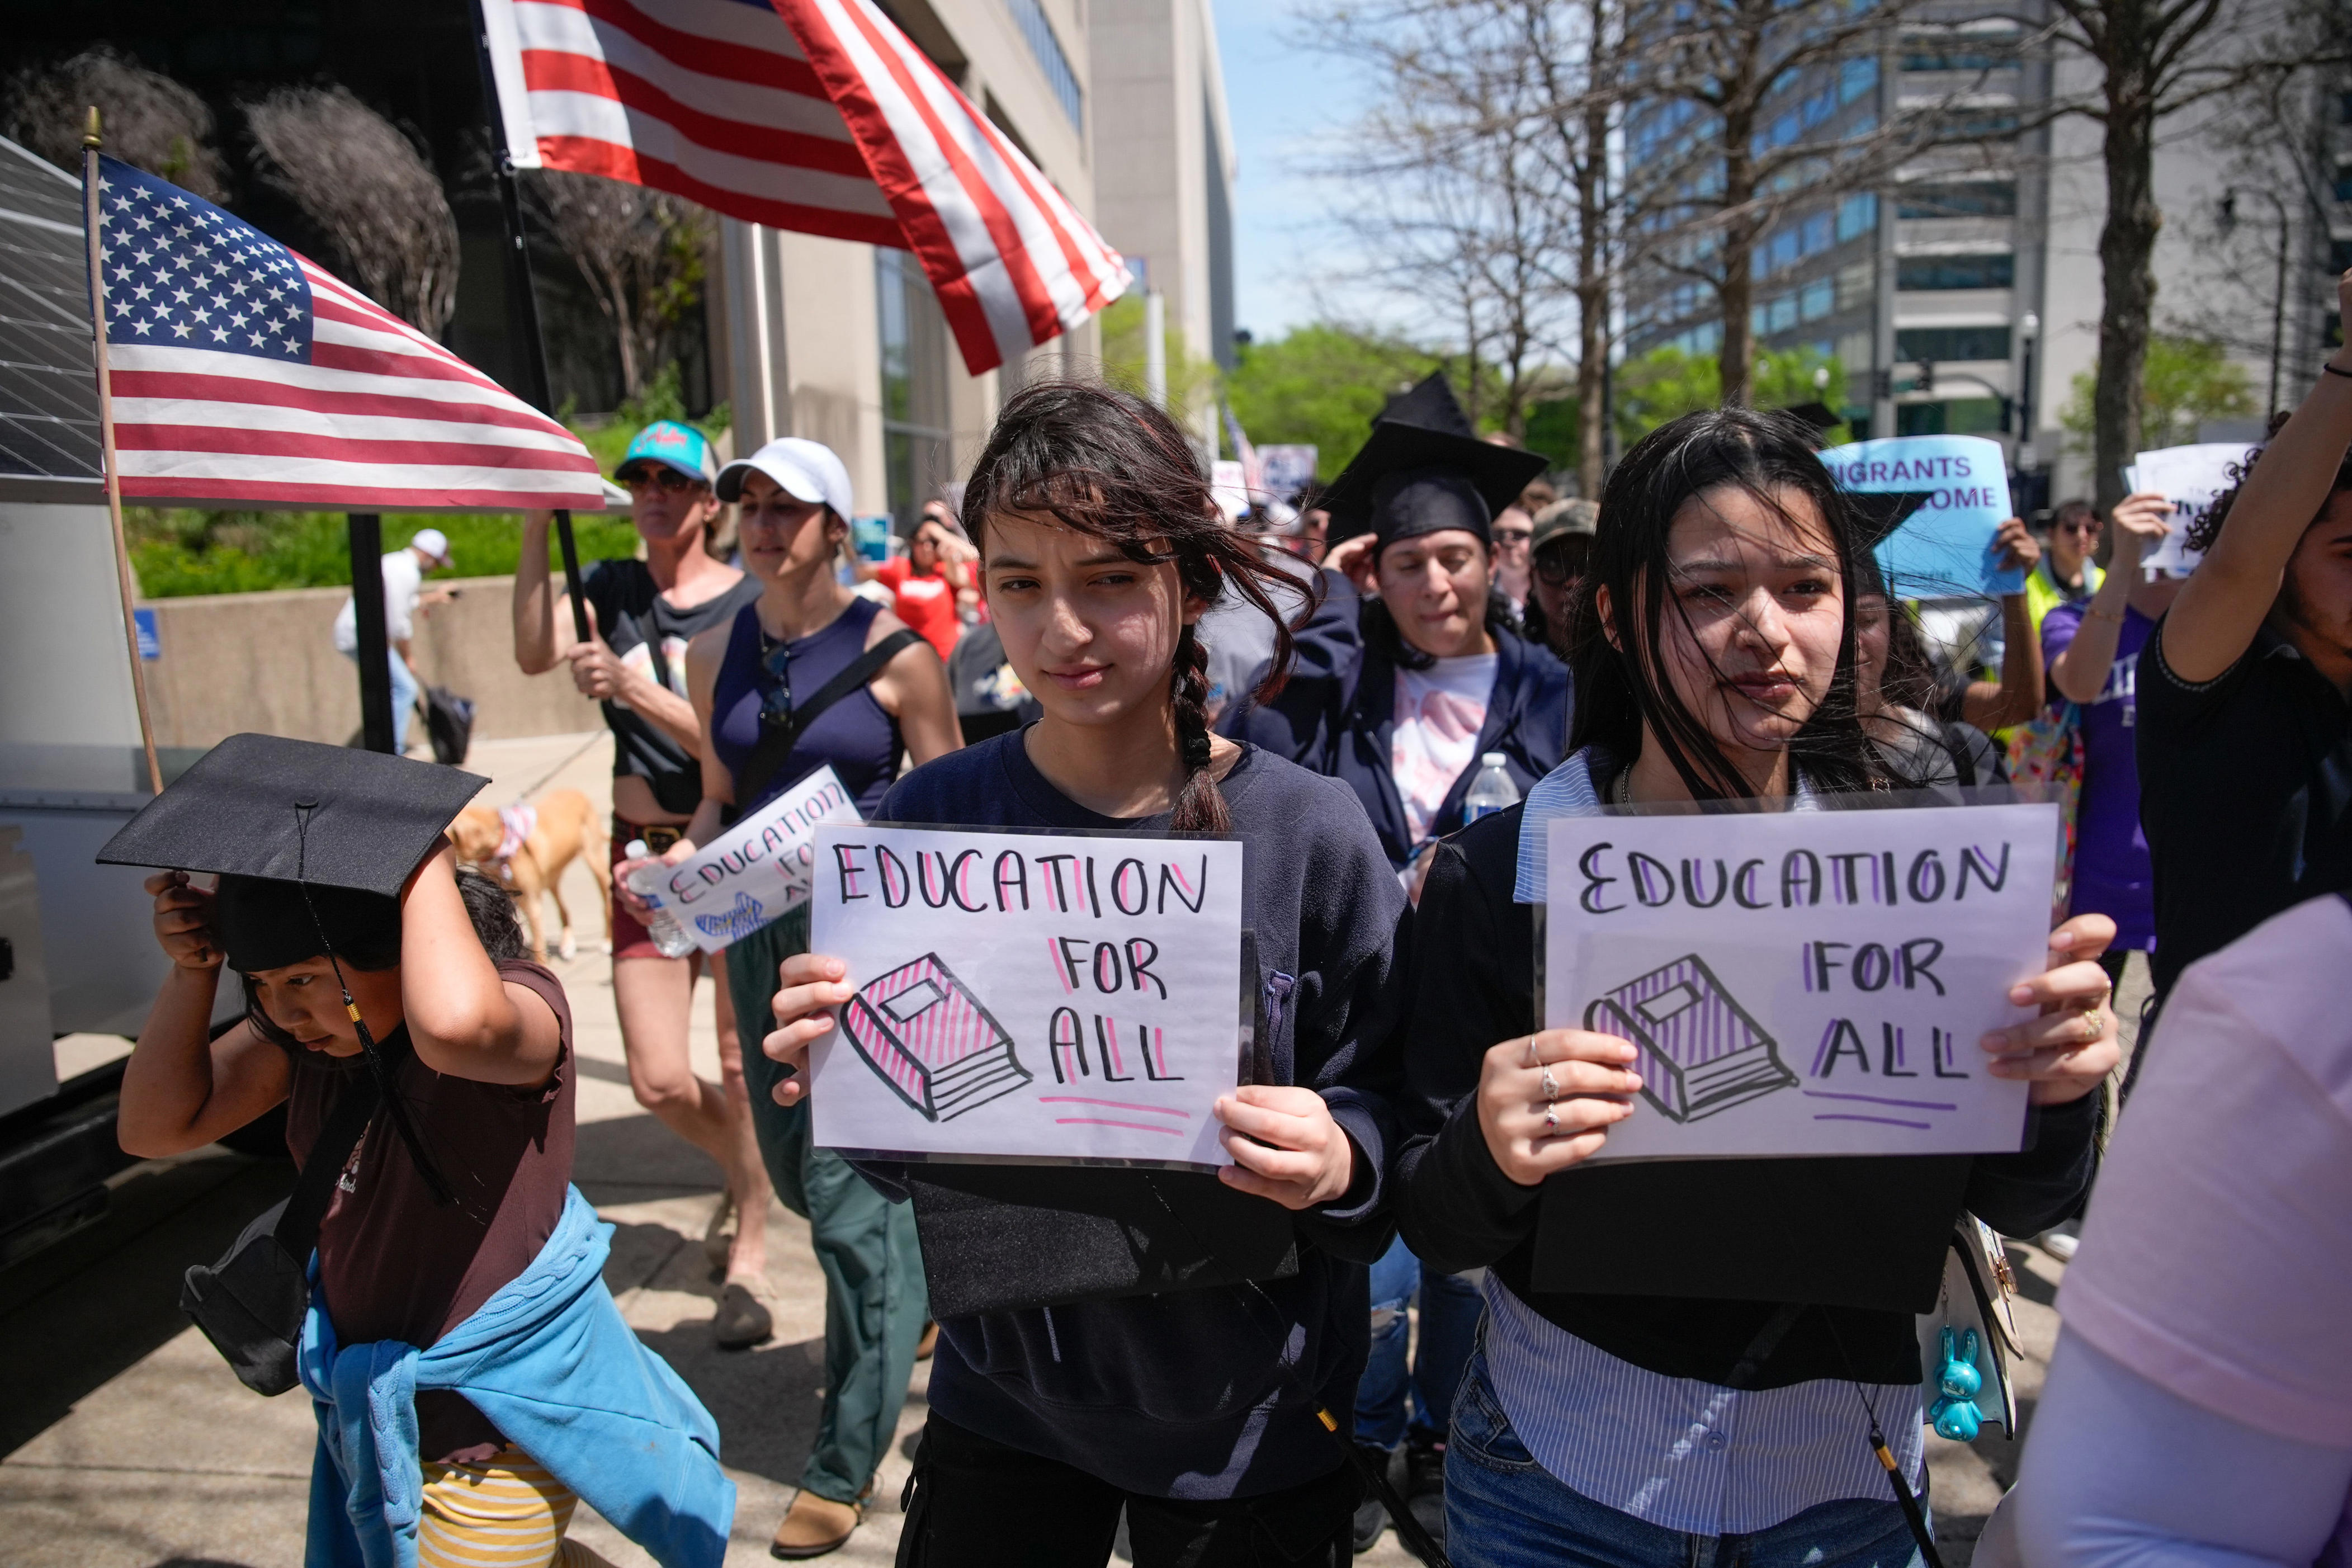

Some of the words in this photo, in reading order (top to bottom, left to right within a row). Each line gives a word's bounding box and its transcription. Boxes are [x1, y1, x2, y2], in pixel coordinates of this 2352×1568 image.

[669, 781, 845, 904] EDUCATION
[774, 843, 813, 879] FO
[833, 844, 1207, 918] EDUCATION
[1579, 841, 2010, 914] EDUCATION
[1049, 937, 1167, 1000] FOR
[1804, 938, 1945, 996] FOR
[1049, 1007, 1185, 1085] ALL
[1811, 1019, 1970, 1079] ALL
